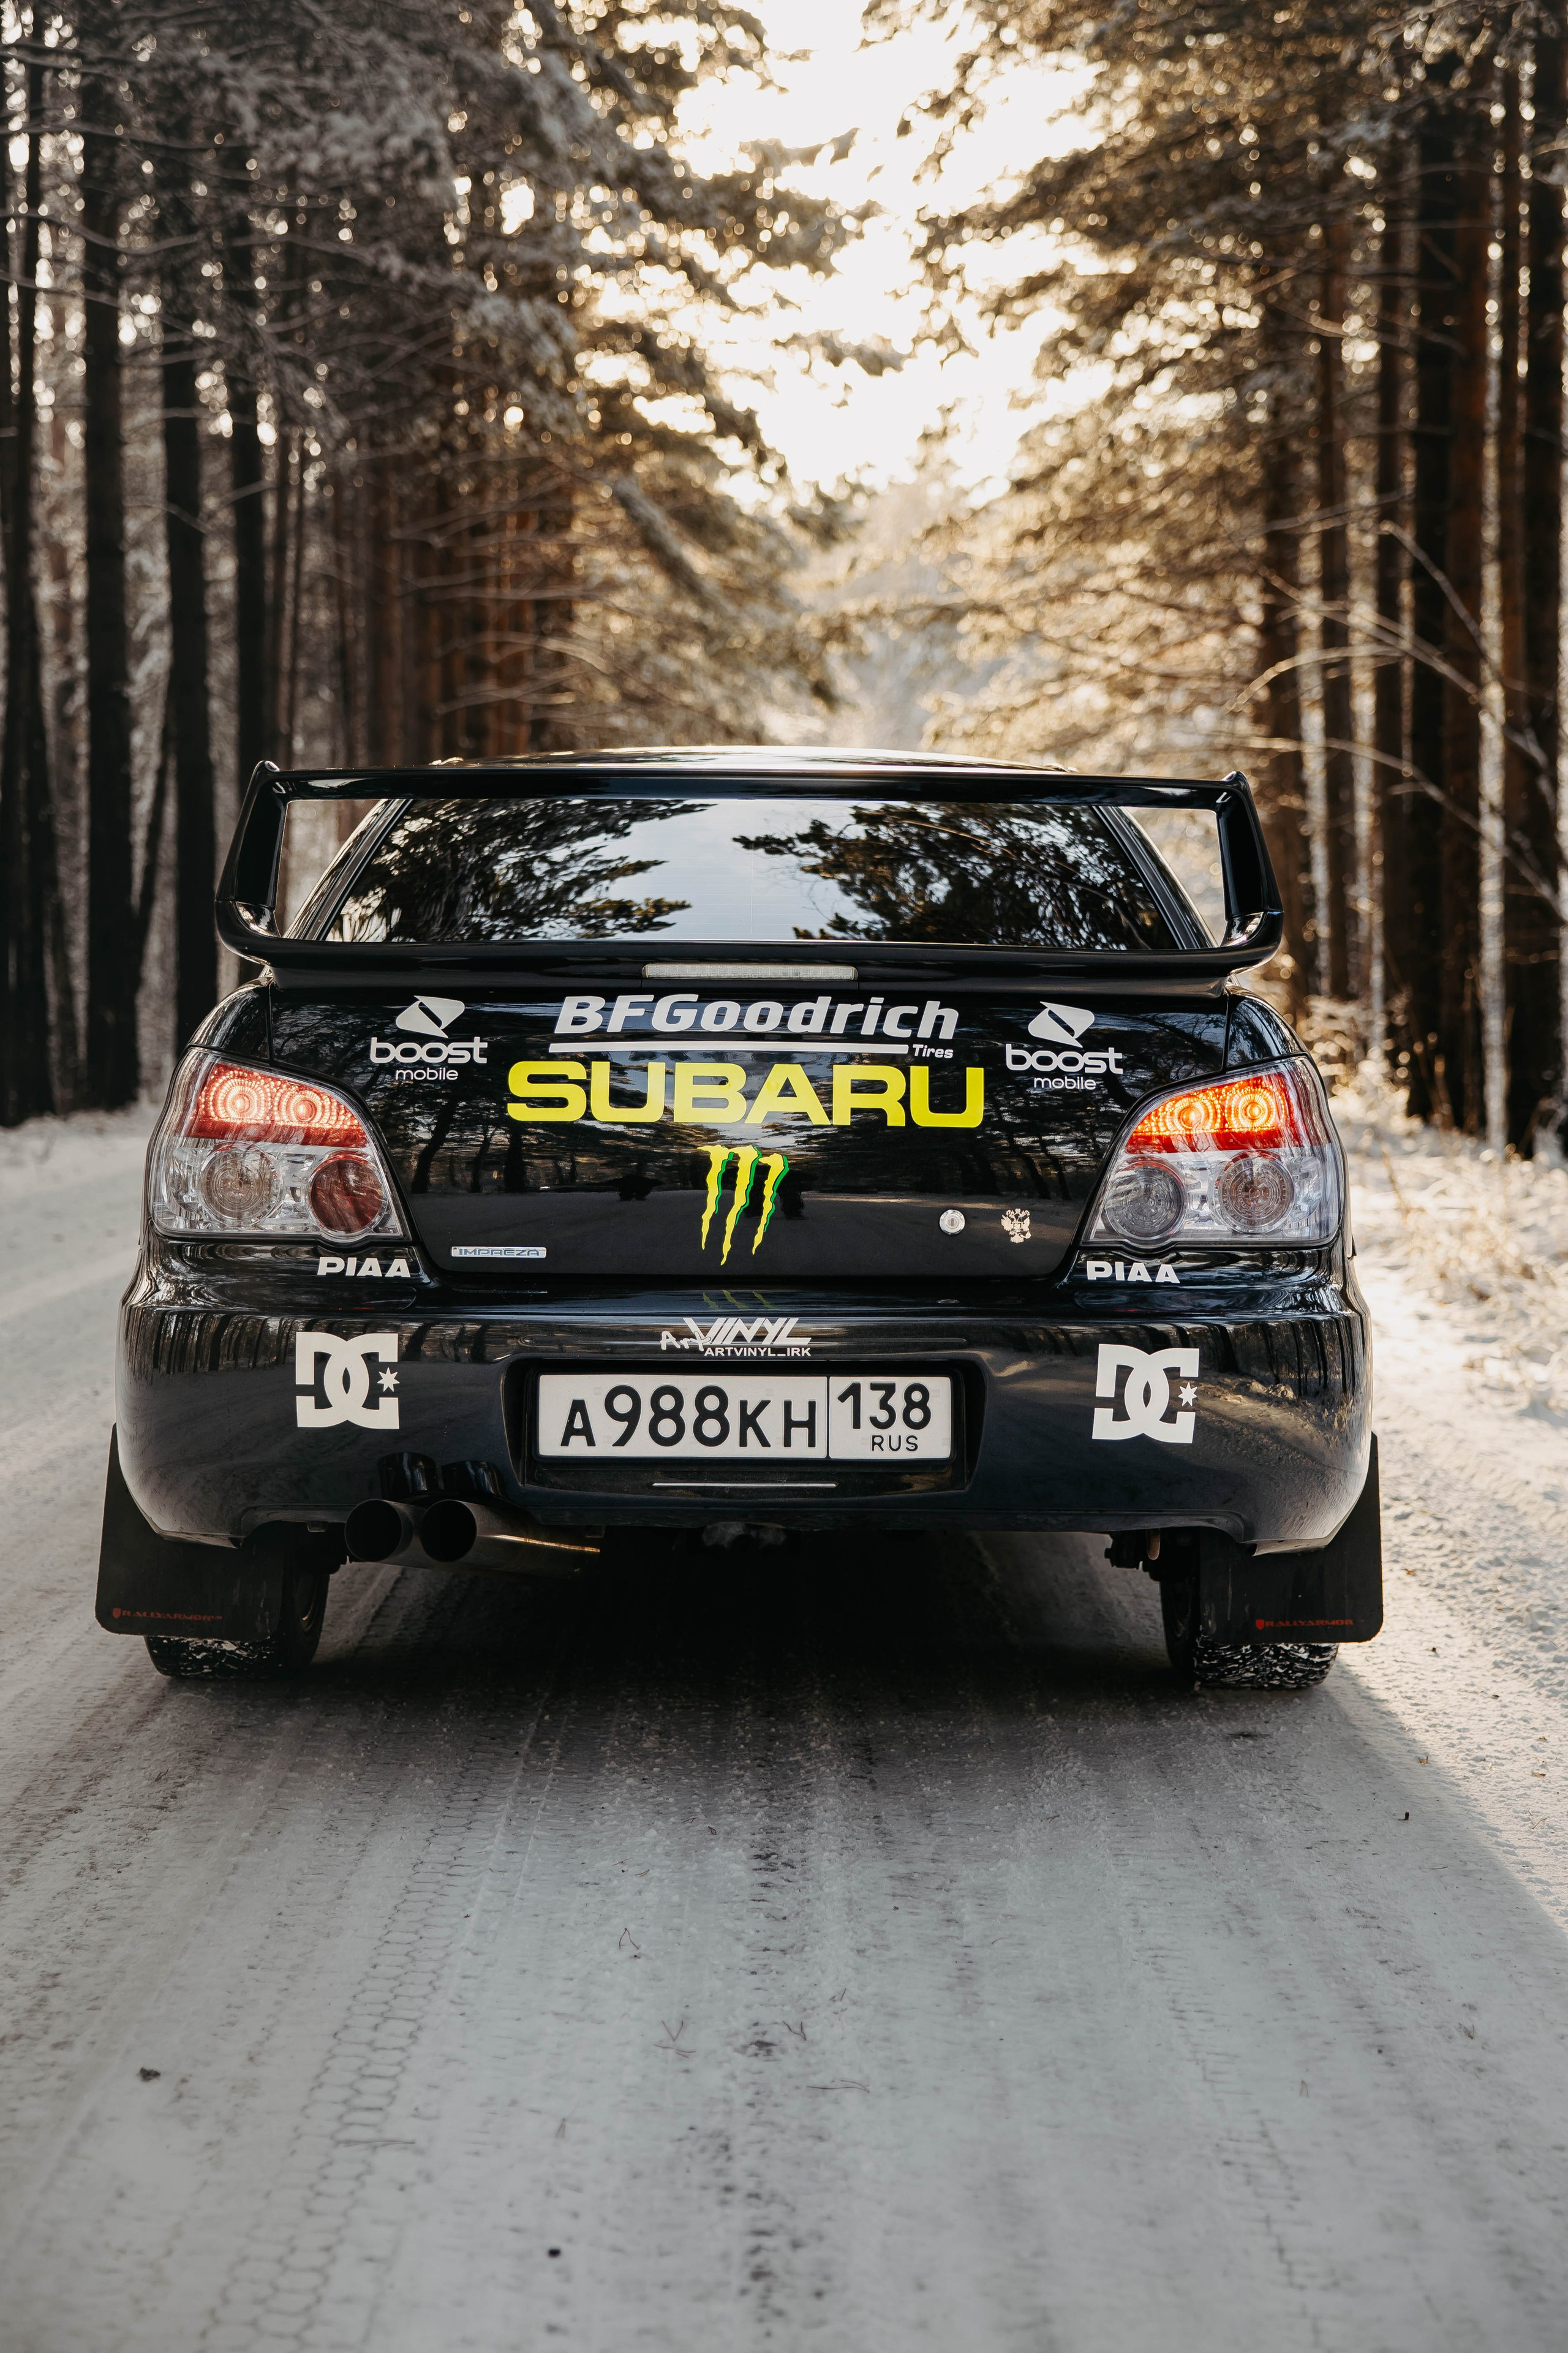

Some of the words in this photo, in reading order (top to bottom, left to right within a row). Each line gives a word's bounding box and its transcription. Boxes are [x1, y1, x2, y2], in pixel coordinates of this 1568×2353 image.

[554, 994, 959, 1040] BFGoodrich
[370, 1037, 488, 1063] boost
[912, 1044, 954, 1059] Tires
[1006, 1044, 1123, 1074] boost
[395, 1067, 458, 1081] mobile
[1034, 1076, 1096, 1090] mobile
[507, 1061, 984, 1128] SUBARU
[317, 1257, 410, 1277] PIAA
[1087, 1261, 1180, 1283] PIAA
[704, 1347, 812, 1357] ARTVINYL_IRK
[837, 1382, 931, 1430] 138
[872, 1435, 919, 1452] RUS
